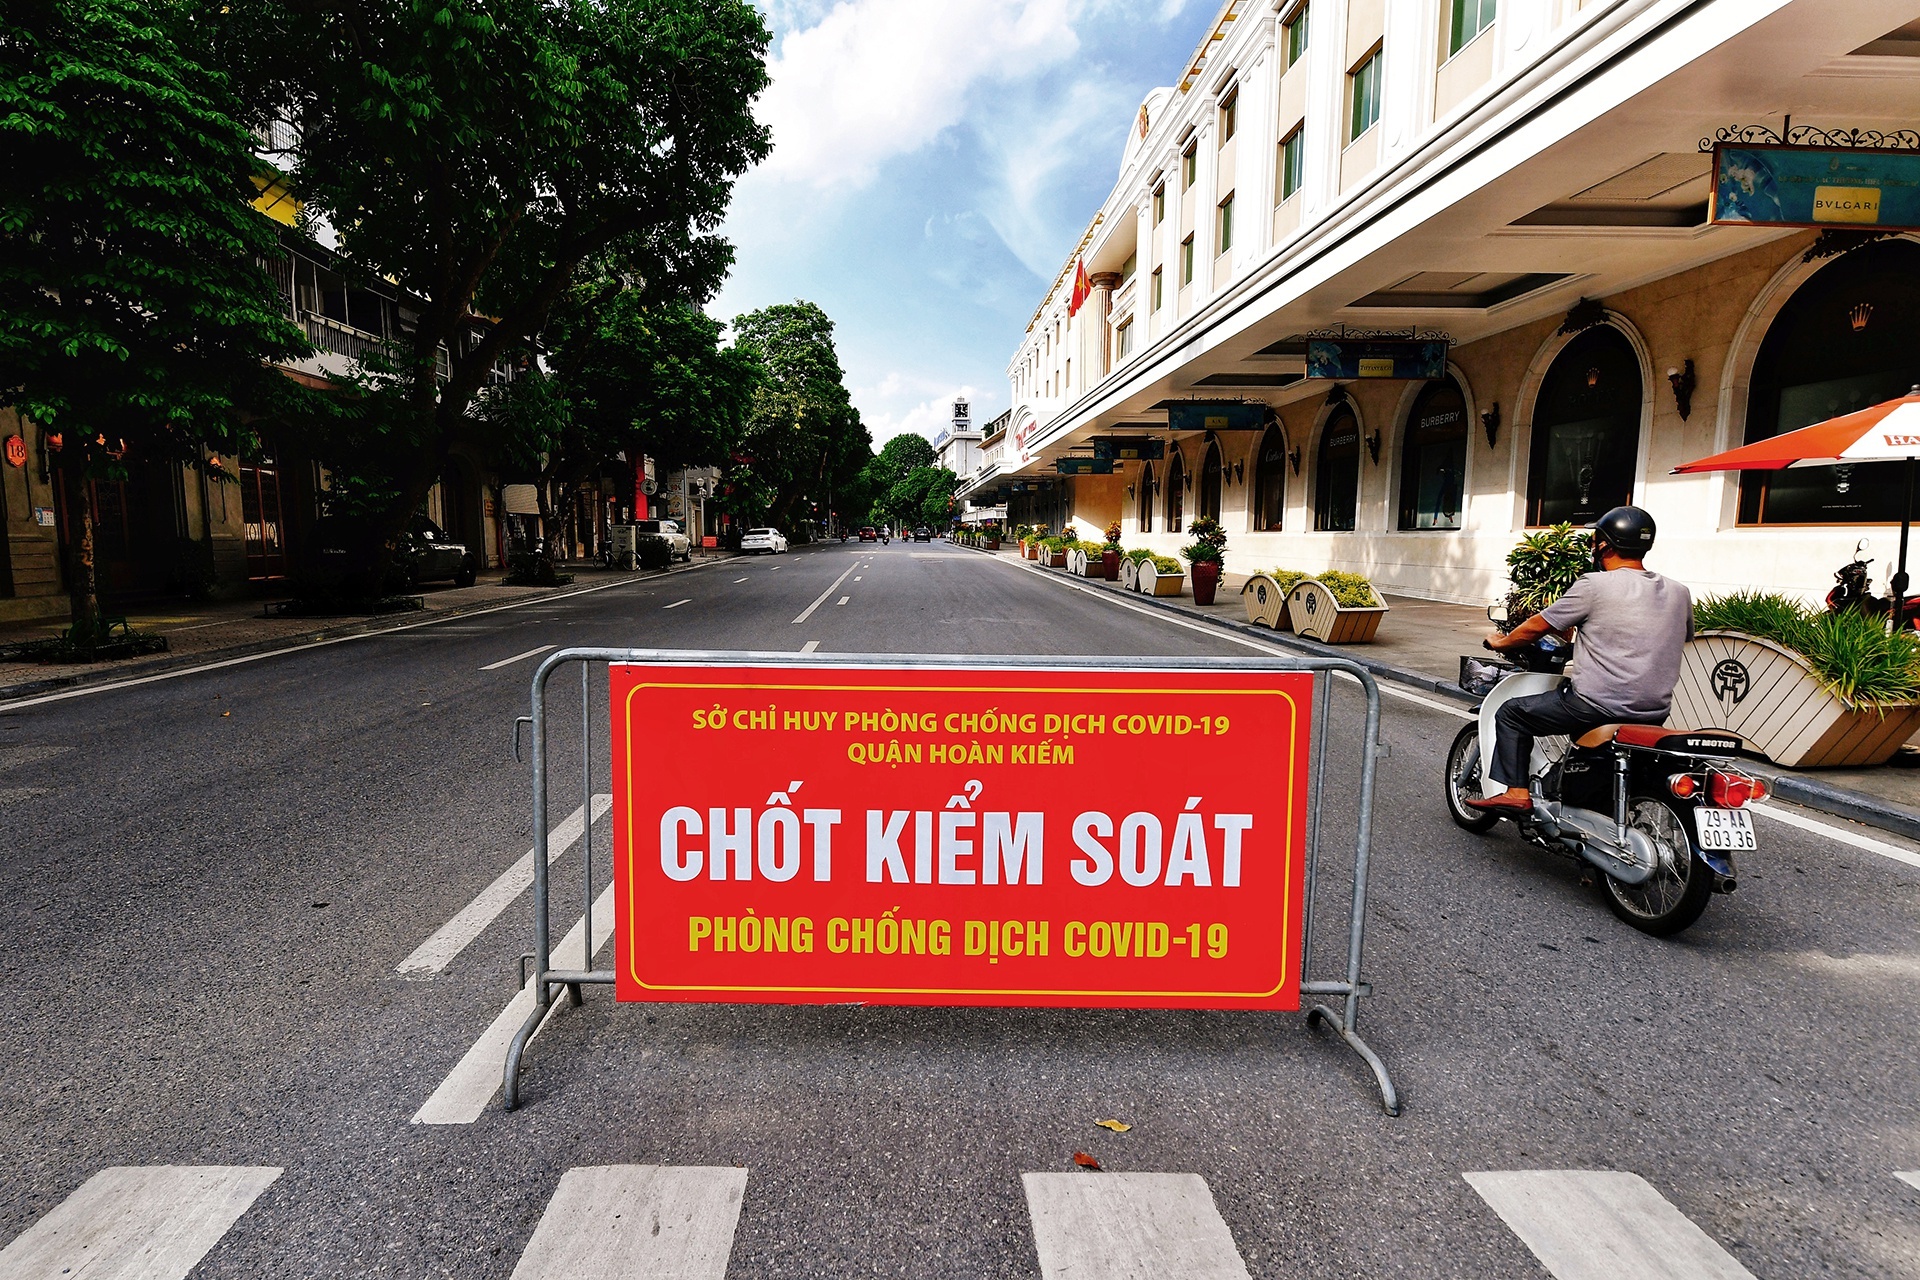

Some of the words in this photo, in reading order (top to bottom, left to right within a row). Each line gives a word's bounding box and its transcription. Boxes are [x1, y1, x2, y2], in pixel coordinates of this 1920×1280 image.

[1815, 200, 1878, 210] BVLGARI
[1420, 410, 1460, 429] BURBERRY
[1329, 433, 1357, 447] BURBERRY
[9, 444, 24, 458] 18
[692, 703, 727, 730] SỞ
[732, 703, 776, 730] CHỈ
[783, 710, 838, 731] HUY
[845, 707, 938, 732] PHÒNG
[944, 706, 1036, 734] CHỐNG
[1044, 713, 1105, 739] DỊCH
[1112, 714, 1230, 735] COVID-19
[1686, 738, 1701, 747] VT
[1701, 739, 1736, 748] MOTOR
[847, 739, 922, 769] QUẬN
[929, 738, 1004, 767] HOÀN
[1011, 738, 1074, 765] KIẾM
[1704, 810, 1745, 828] 29-AA
[659, 780, 842, 883] CHỐT
[865, 779, 1045, 885] KIỂM
[1070, 796, 1254, 888] SOÁT
[1703, 830, 1754, 848] 803.36
[689, 907, 814, 954] PHÒNG
[826, 905, 951, 956] CHỐNG
[964, 920, 1049, 964] DỊCH
[1063, 920, 1230, 959] COVID-19
